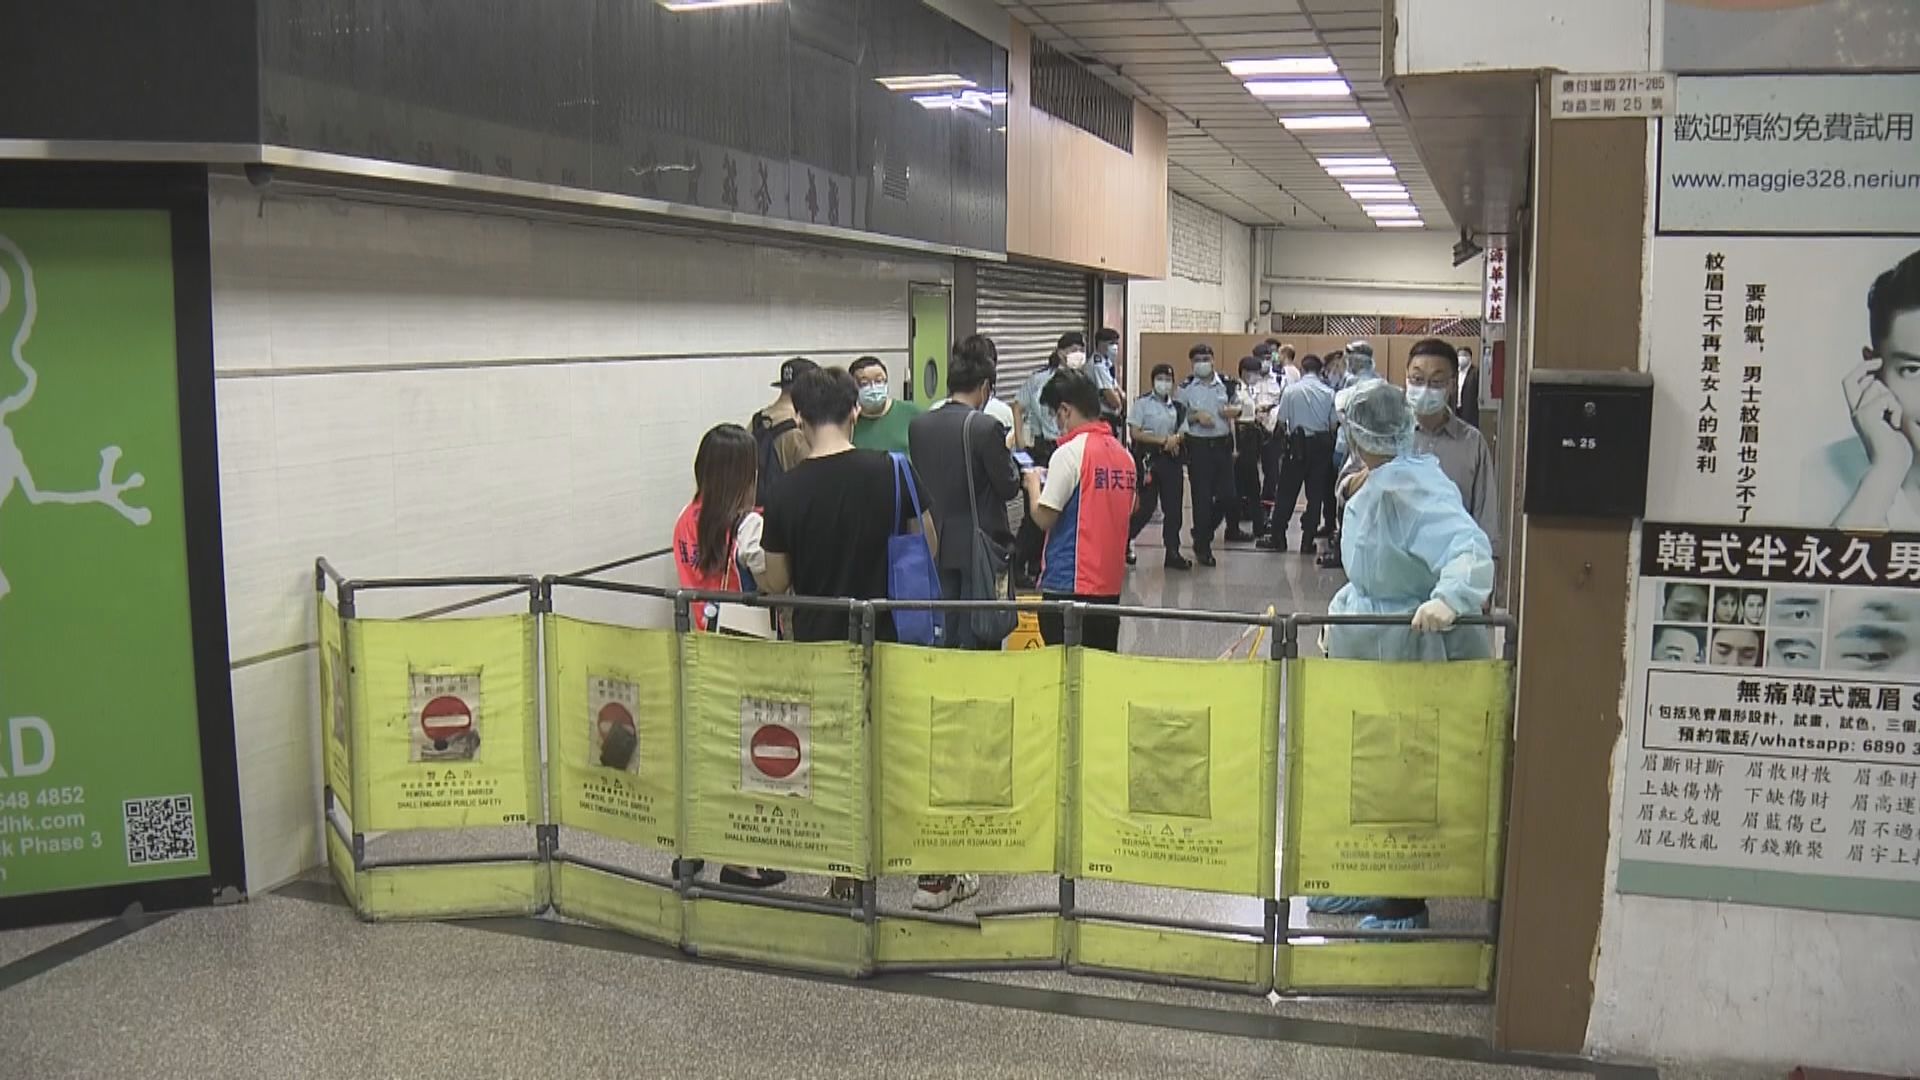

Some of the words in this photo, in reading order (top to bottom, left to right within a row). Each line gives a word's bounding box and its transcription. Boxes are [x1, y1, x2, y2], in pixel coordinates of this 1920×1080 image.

[1623, 98, 1642, 111] 25
[1673, 112, 1914, 142] 歡迎預約免費試用
[1696, 252, 1726, 473] 紋眉已不再是女人的專利
[1580, 438, 1596, 448] 25
[1656, 530, 1920, 581] 韓式半永久男
[1736, 679, 1901, 711] 無痛韓式飄眉
[0, 715, 56, 777] D
[1862, 739, 1906, 755] 6890
[1640, 753, 1725, 777] 眉斷財斷
[1746, 761, 1832, 784] 眉散財散
[36, 786, 85, 807] 4852
[1639, 780, 1723, 803] 上缺傷情
[1744, 787, 1830, 810] 下缺傷財
[1852, 793, 1920, 816] 眉高運
[503, 813, 526, 823] OTIS
[1849, 819, 1920, 841] 眉不過
[20, 835, 84, 856] Phase
[91, 831, 102, 848] 3
[657, 835, 675, 847] OTIS
[1635, 828, 1718, 851] 眉尾散亂
[1739, 835, 1824, 860] 有錢難聚
[828, 863, 852, 872] OTIS
